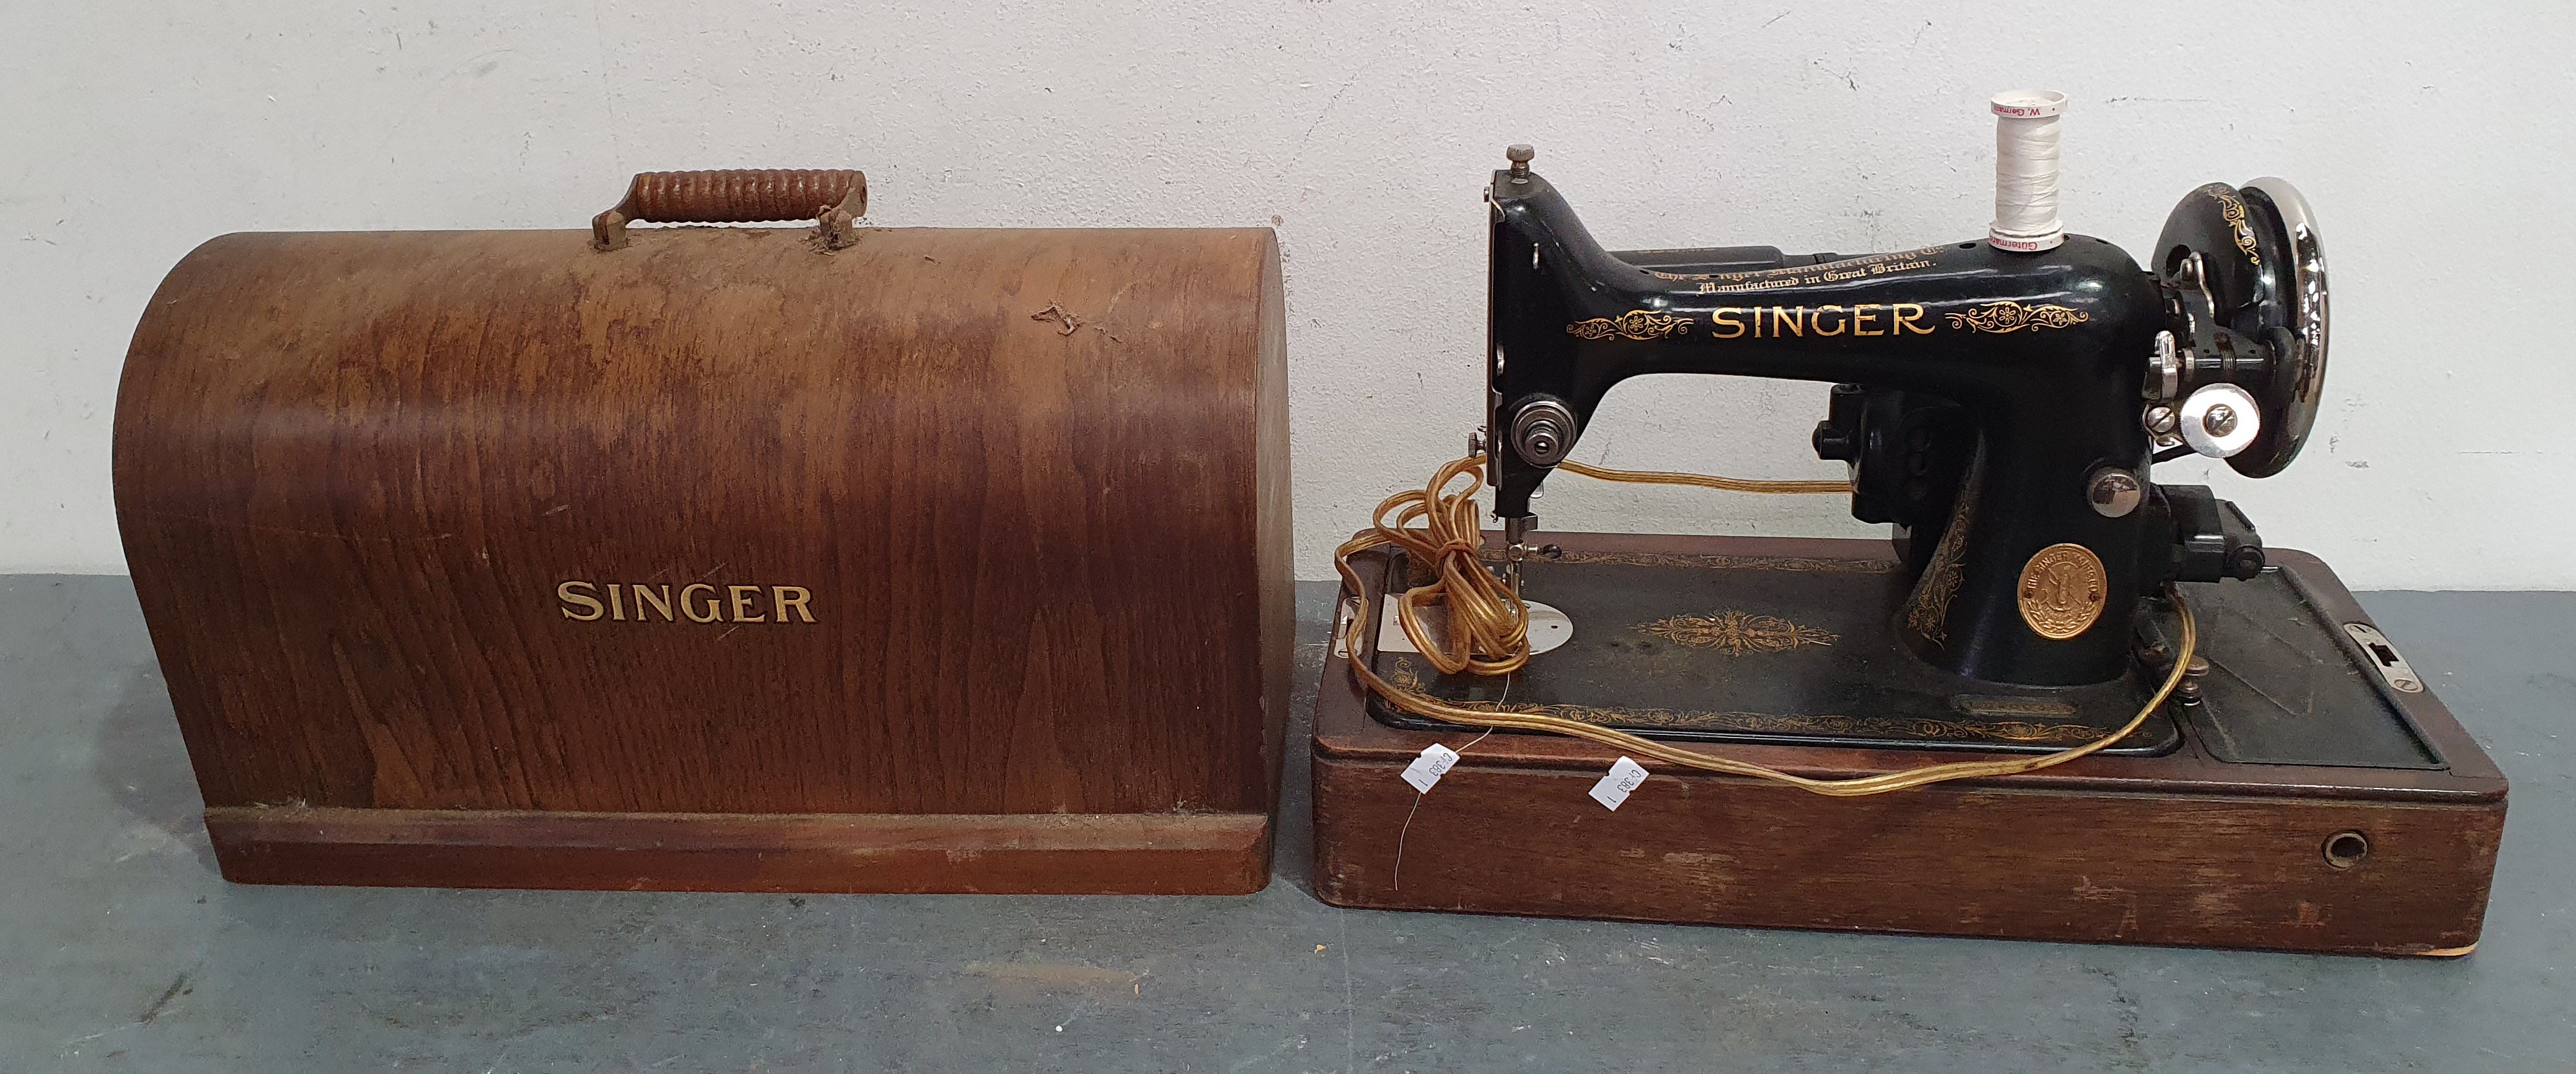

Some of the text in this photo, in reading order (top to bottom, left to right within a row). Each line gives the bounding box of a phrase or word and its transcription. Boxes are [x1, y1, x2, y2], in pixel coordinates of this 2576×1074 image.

[2028, 108, 2041, 116] W.
[1696, 276, 1800, 296] Manufactured
[1804, 275, 1820, 284] in
[1823, 267, 1868, 282] Great
[1711, 304, 1936, 338] SINGER
[558, 581, 818, 623] SINGER
